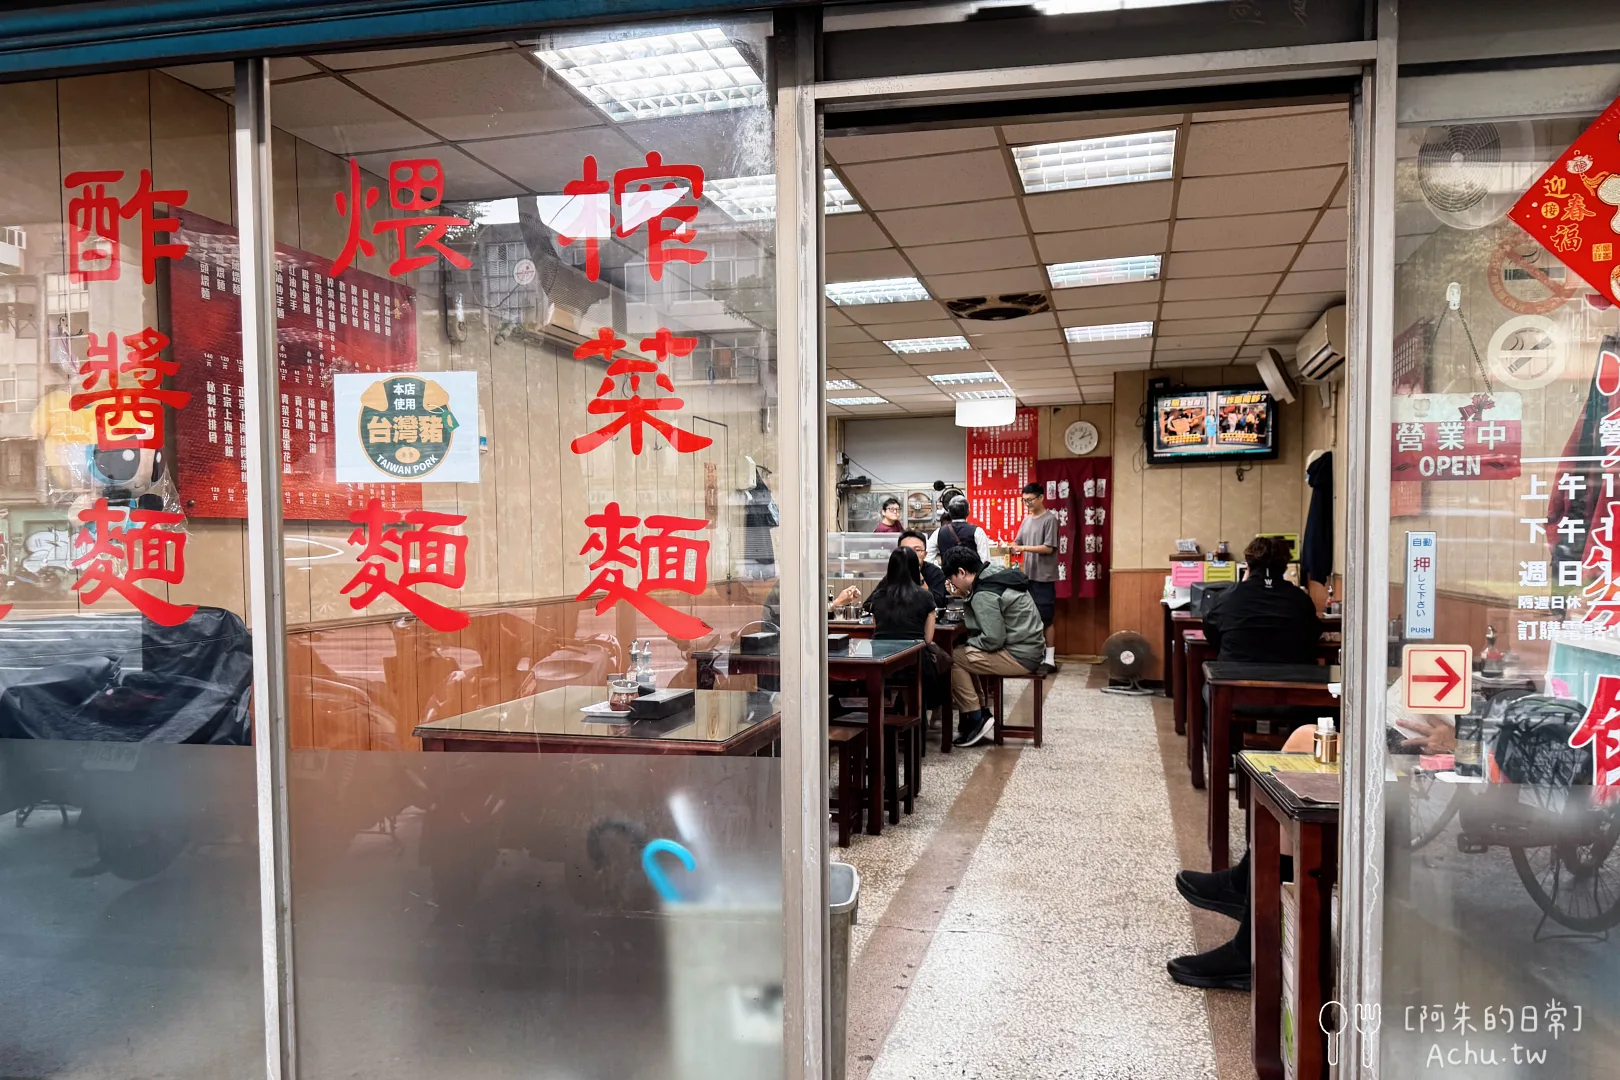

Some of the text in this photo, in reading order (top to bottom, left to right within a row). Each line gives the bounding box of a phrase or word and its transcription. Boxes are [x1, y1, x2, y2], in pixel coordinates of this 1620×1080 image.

[64, 169, 199, 626] 酢醬麵
[330, 158, 473, 632] 煨麵
[393, 383, 416, 395] 本店
[558, 151, 713, 639] 榨菜麵
[394, 399, 416, 410] 使用
[367, 415, 443, 443] 台灣豬
[1395, 421, 1506, 452] 營業中
[377, 454, 439, 474] TAIWAN PORK
[1419, 455, 1481, 476] OPEN
[1412, 538, 1432, 546] 自動
